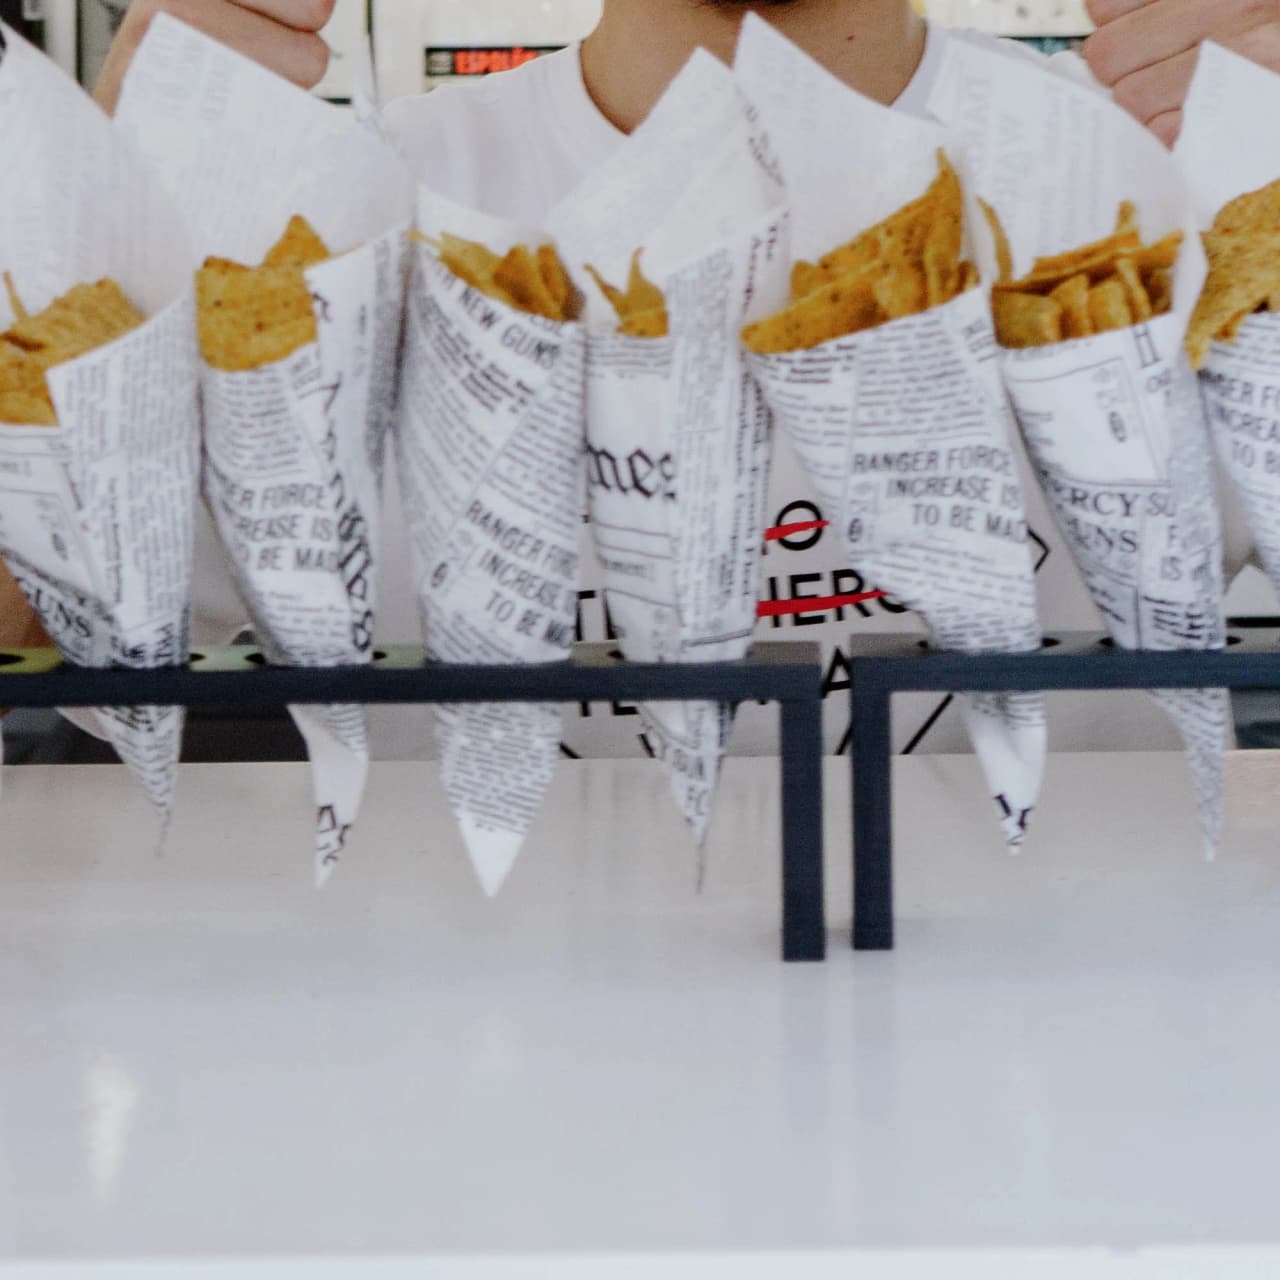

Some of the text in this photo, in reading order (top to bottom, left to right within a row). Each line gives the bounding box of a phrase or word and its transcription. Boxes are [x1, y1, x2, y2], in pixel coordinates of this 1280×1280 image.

[584, 440, 679, 501] mes
[852, 445, 1013, 477] RANGER FORCE
[261, 482, 329, 511] FORCE
[885, 476, 993, 504] INCREASE
[310, 515, 333, 542] IS
[466, 498, 544, 563] RANGER
[911, 503, 1028, 544] TO BE MAD
[257, 545, 283, 572] BE
[294, 545, 340, 572] MAD
[484, 589, 517, 623] TO
